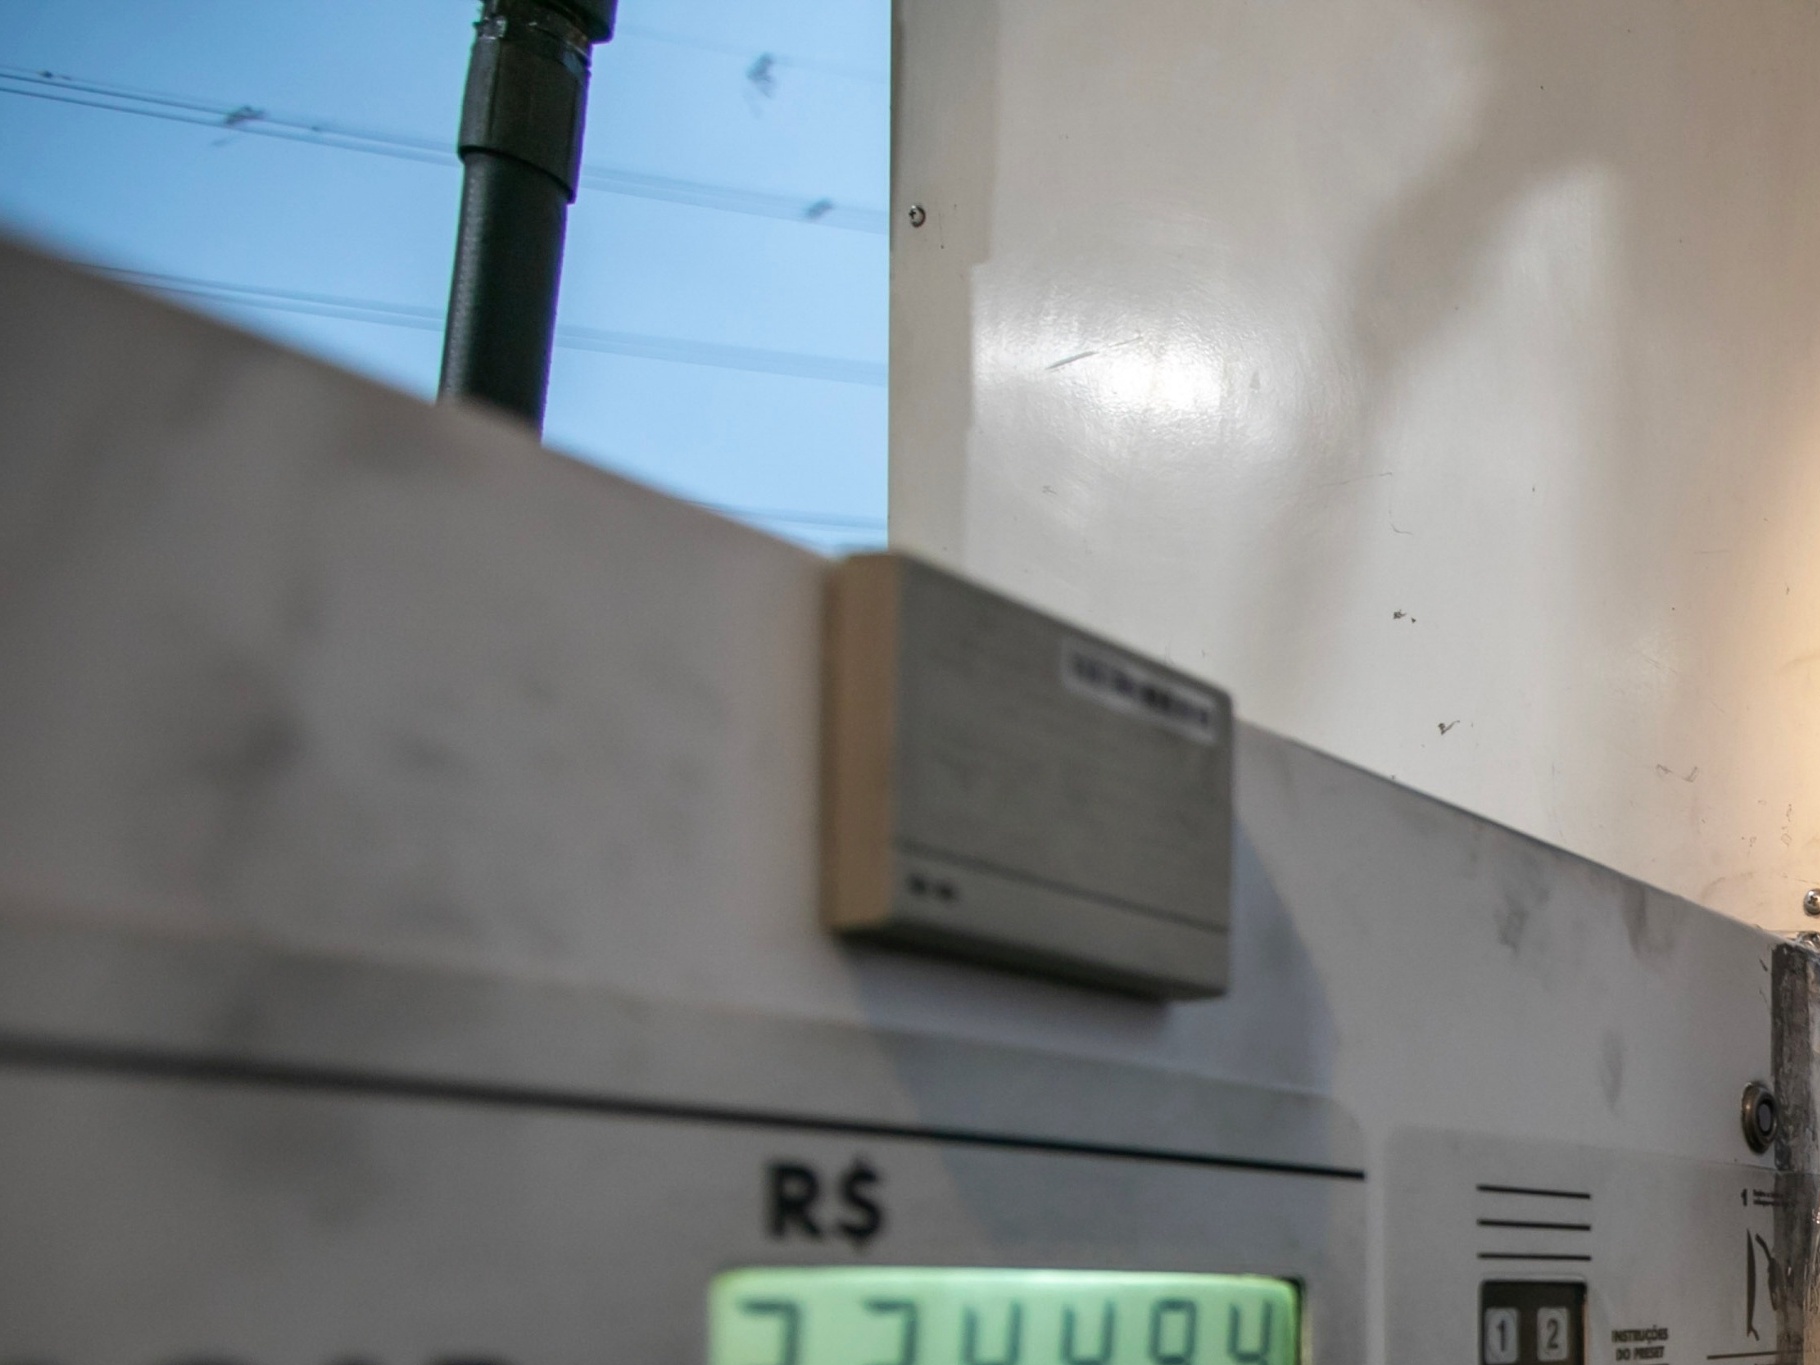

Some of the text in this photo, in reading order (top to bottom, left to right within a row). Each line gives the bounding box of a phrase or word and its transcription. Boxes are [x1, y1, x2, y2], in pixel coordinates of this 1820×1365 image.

[764, 1156, 885, 1249] R$
[1495, 1317, 1560, 1354] 1 2
